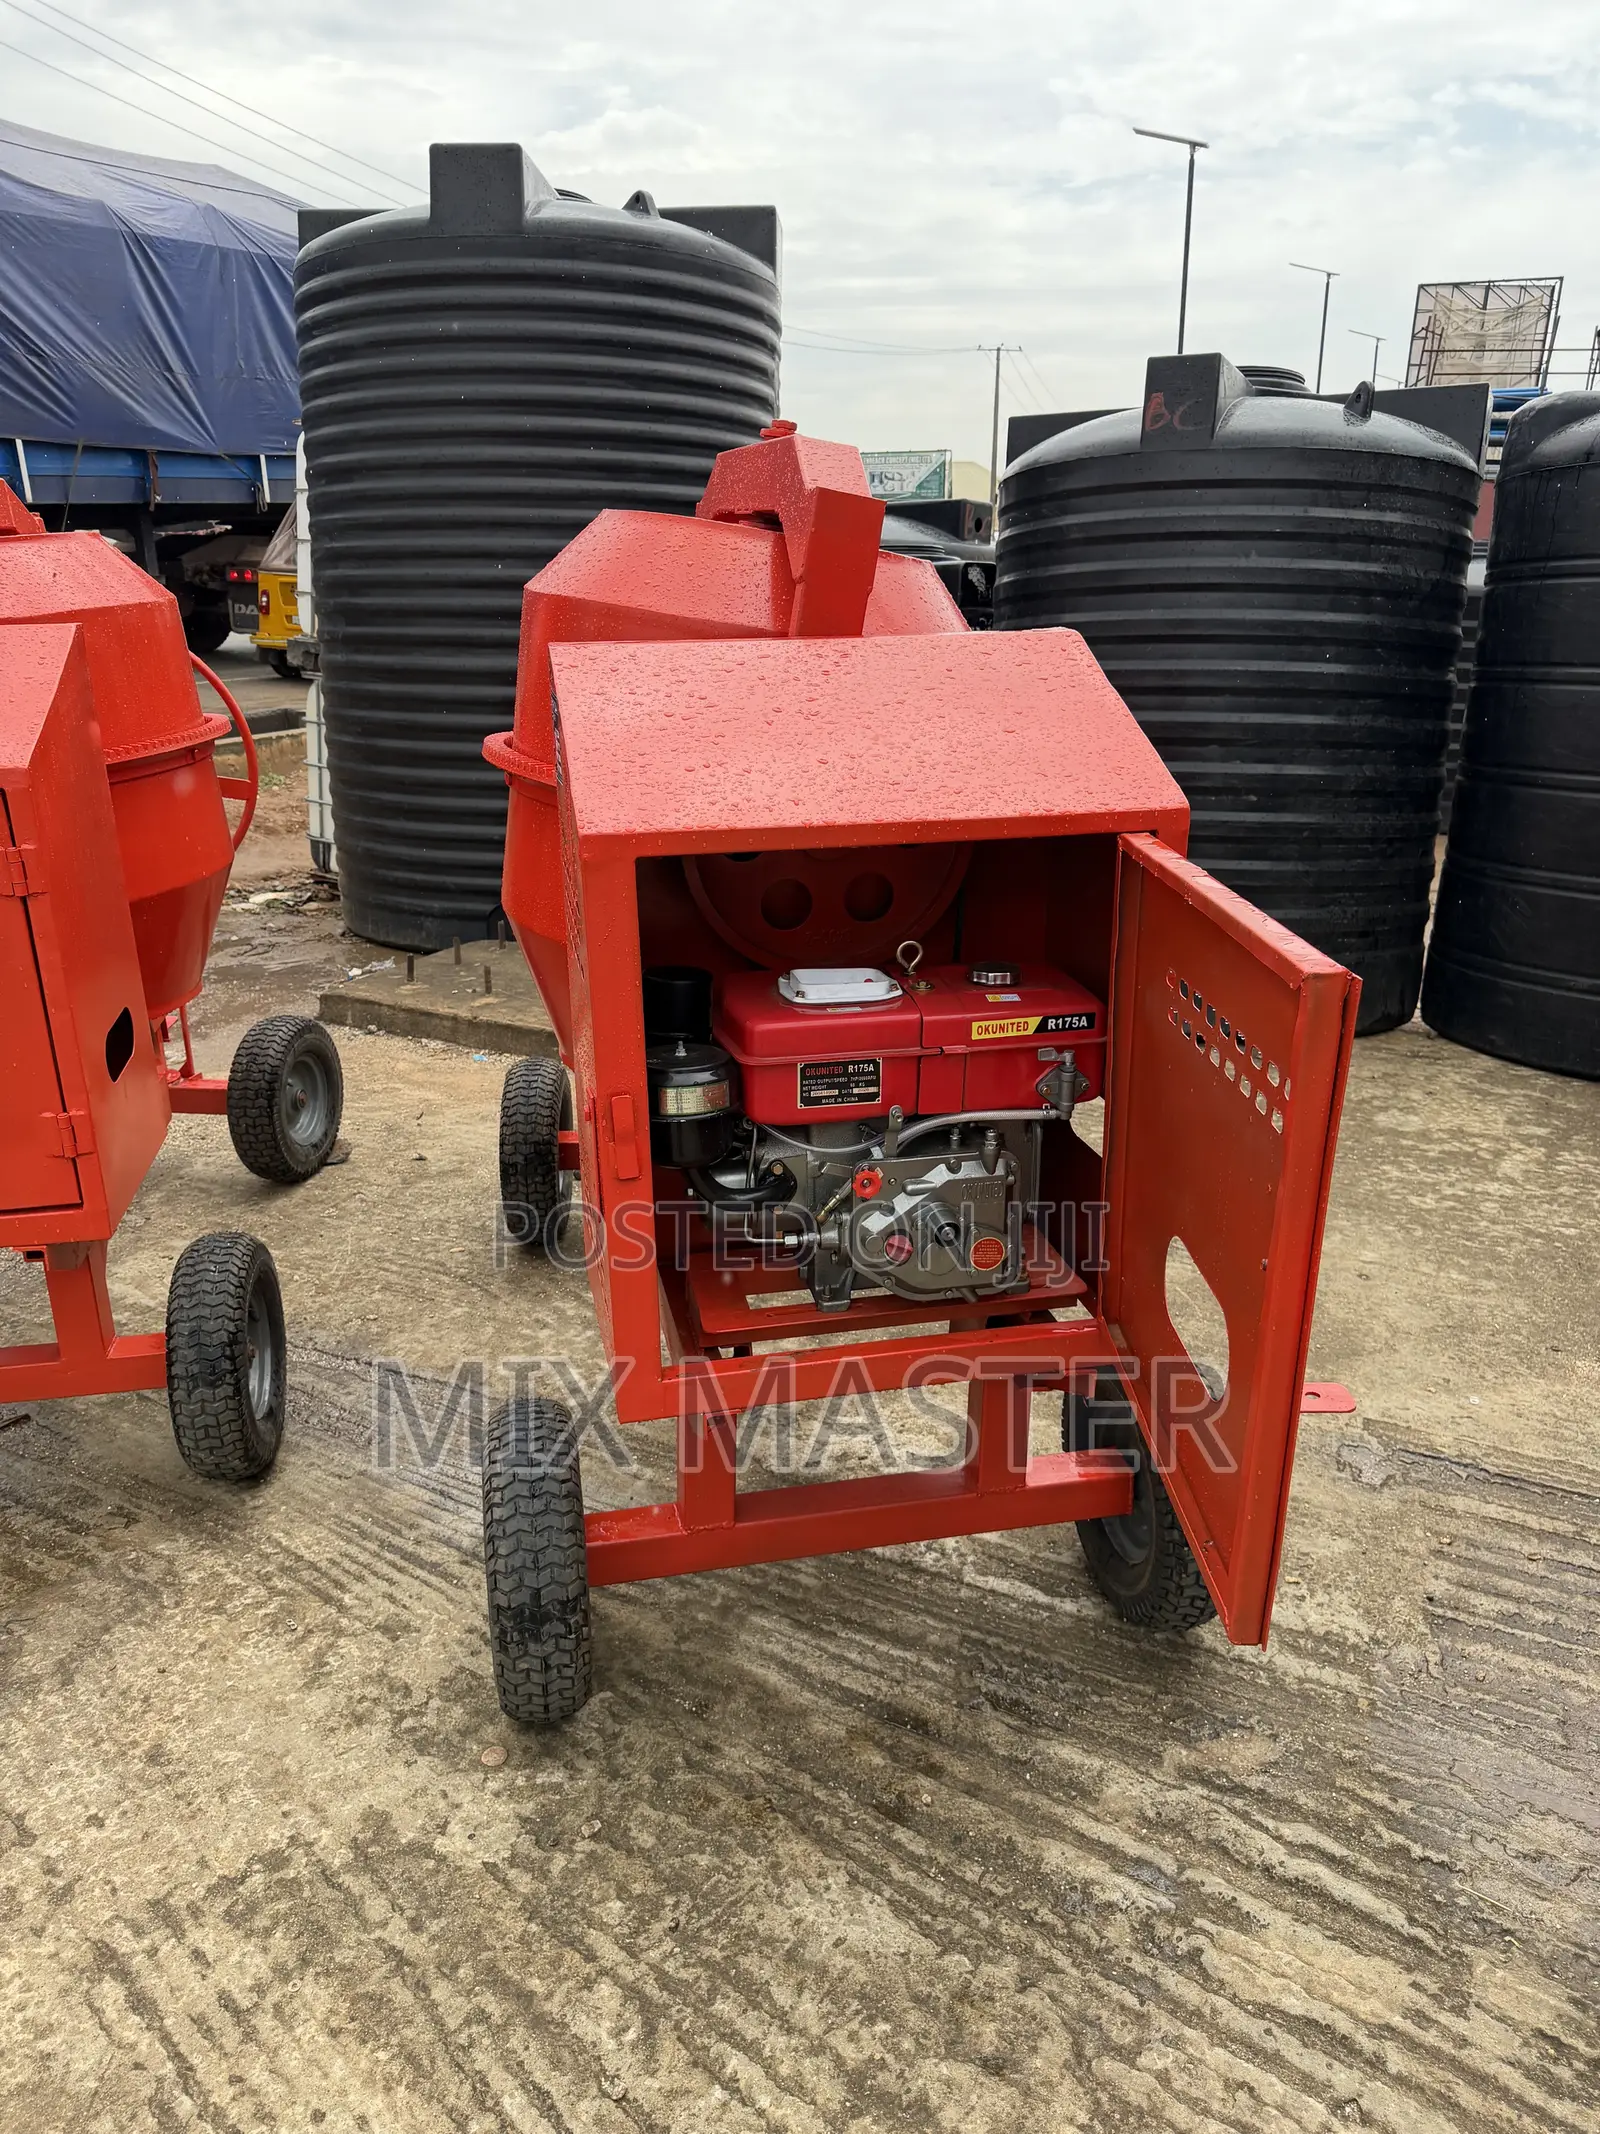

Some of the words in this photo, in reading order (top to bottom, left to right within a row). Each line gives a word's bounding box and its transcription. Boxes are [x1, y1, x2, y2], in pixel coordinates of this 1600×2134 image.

[977, 1021, 1029, 1036] OKUNITED
[1047, 1016, 1088, 1030] R175A
[805, 1066, 844, 1076] OKUNITED
[848, 1063, 875, 1073] R175A
